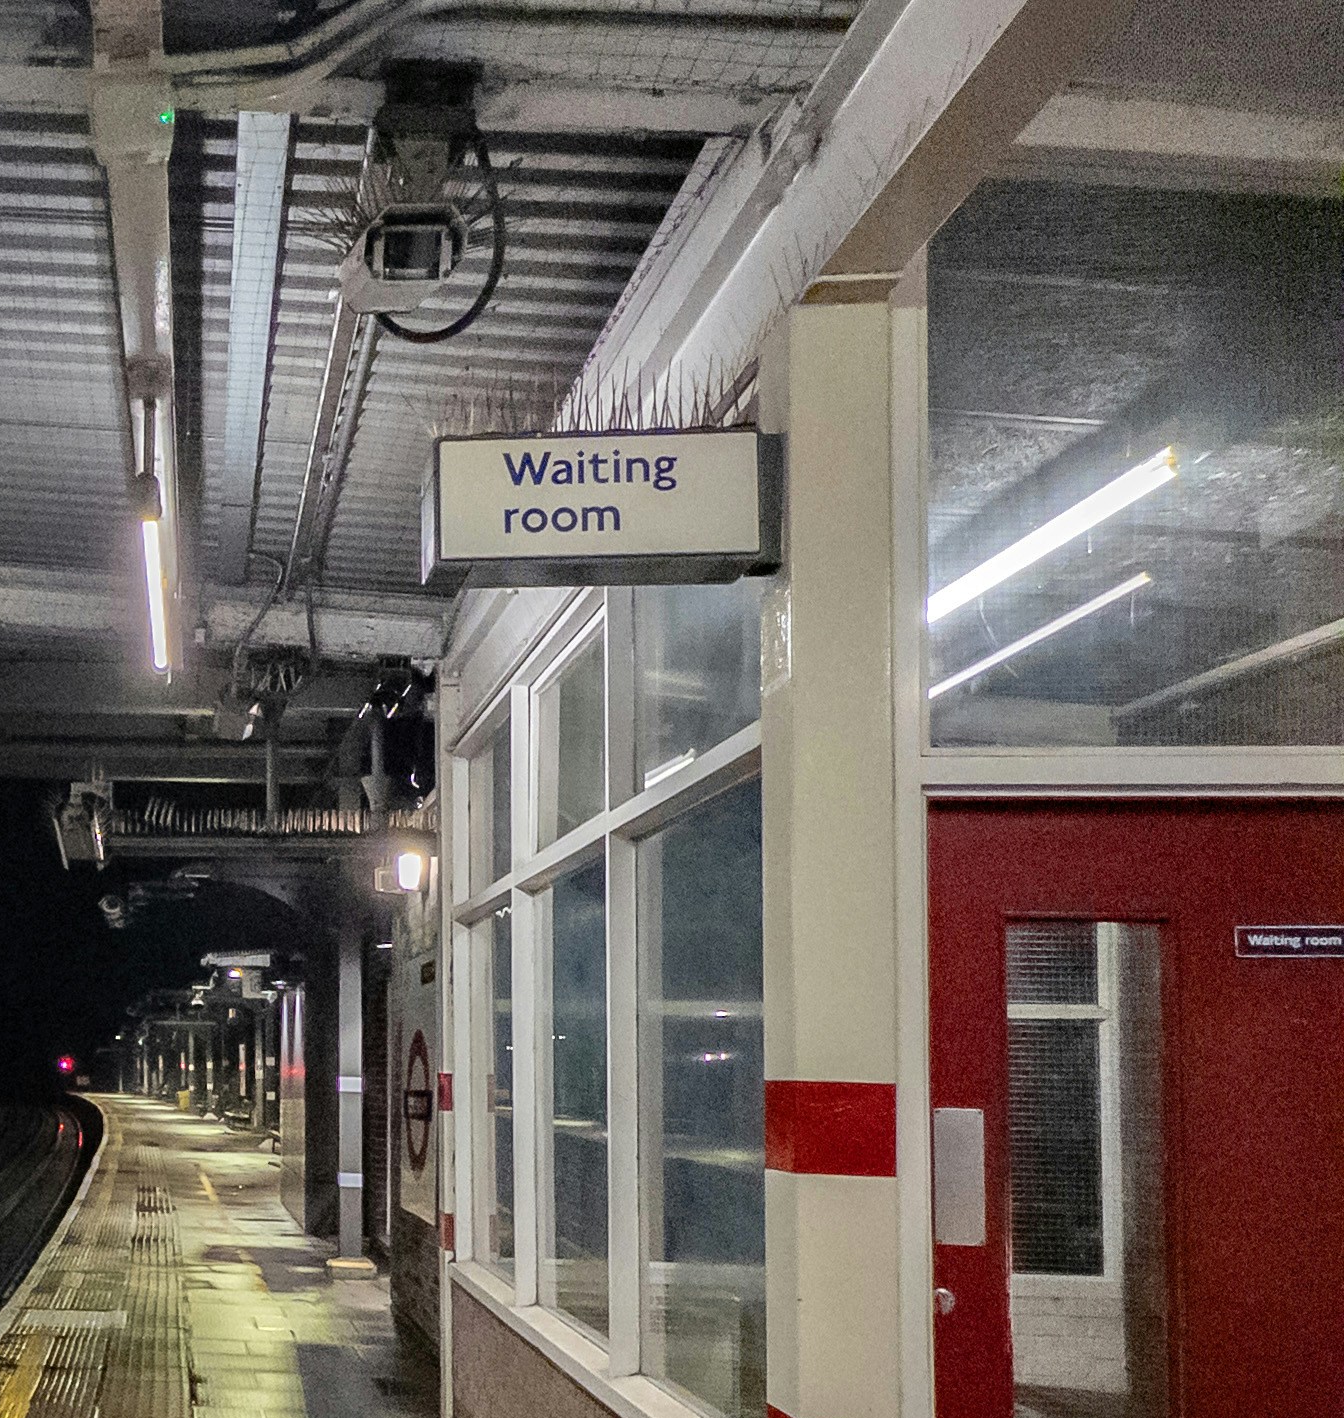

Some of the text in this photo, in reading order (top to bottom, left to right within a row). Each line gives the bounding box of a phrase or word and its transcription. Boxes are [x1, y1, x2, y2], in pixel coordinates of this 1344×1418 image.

[502, 448, 678, 492] Waiting
[503, 504, 622, 534] room
[1247, 934, 1342, 948] Waiting room
